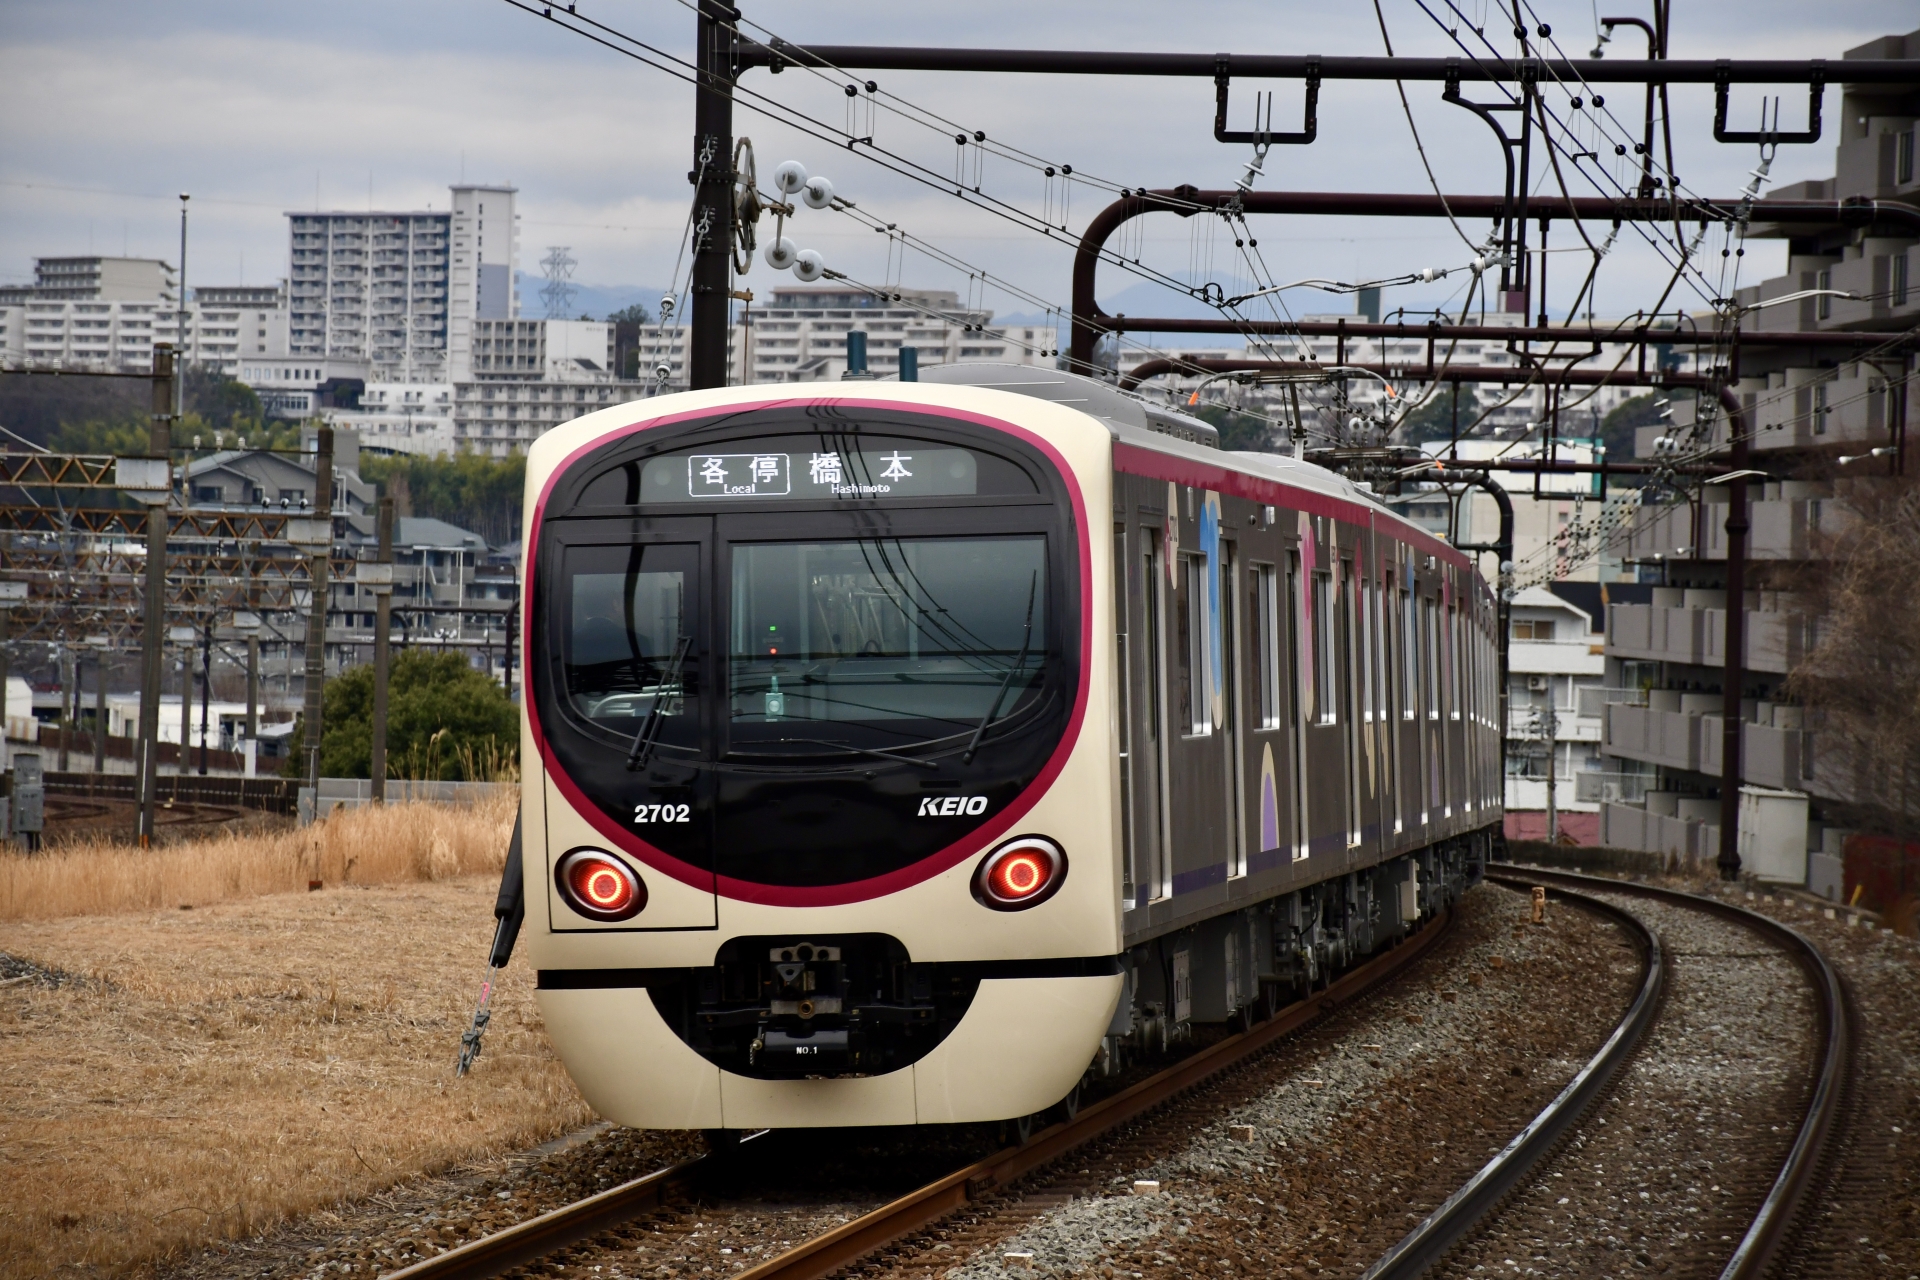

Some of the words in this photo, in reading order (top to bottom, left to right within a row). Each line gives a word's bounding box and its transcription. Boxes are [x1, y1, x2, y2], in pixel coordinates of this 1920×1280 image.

[700, 456, 779, 484] 各停
[809, 450, 913, 484] 橋本
[723, 483, 756, 494] Local
[831, 483, 891, 494] Hashimoto
[634, 804, 690, 823] 2702
[917, 796, 988, 817] KEIO
